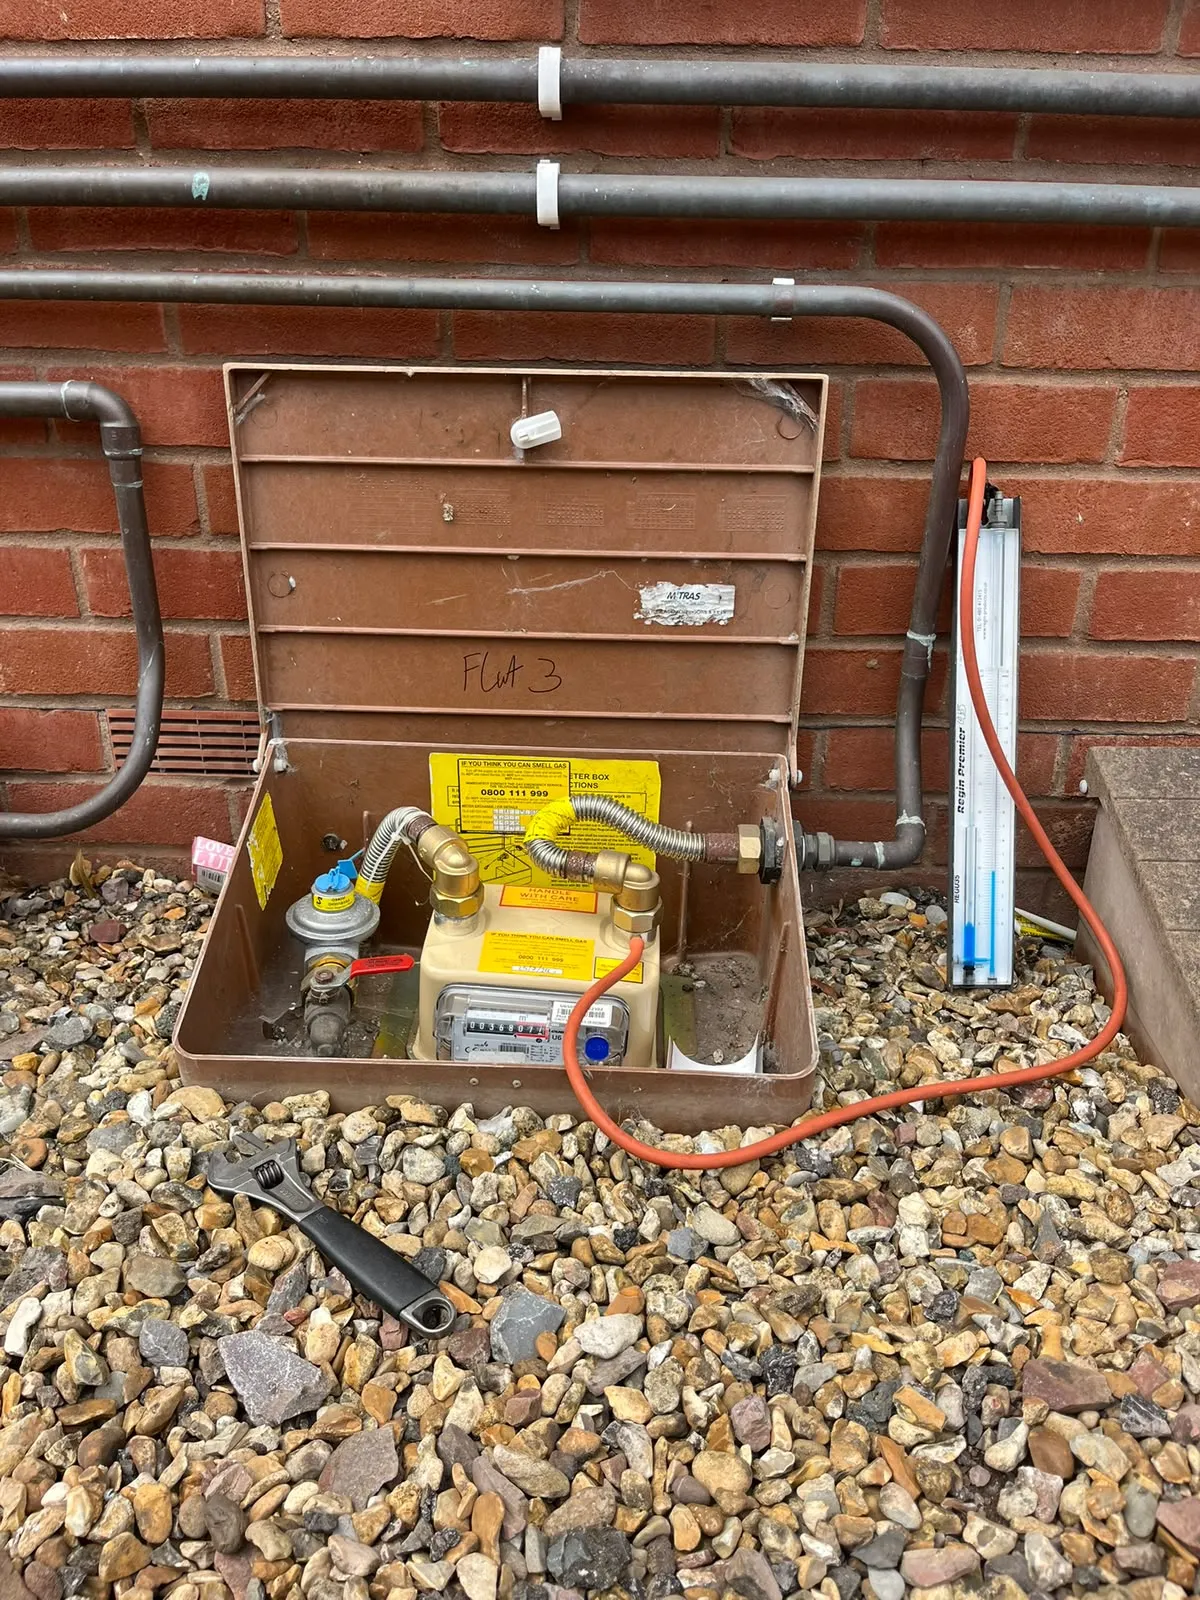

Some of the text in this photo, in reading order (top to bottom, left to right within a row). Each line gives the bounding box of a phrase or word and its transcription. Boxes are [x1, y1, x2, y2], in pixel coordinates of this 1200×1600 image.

[666, 591, 701, 601] MTRAS
[528, 658, 563, 693] 3
[956, 727, 966, 814] Regin Premier
[592, 773, 610, 781] BOX
[509, 789, 526, 797] 111
[196, 839, 235, 854] LOVE
[520, 892, 580, 902] WITH CARE
